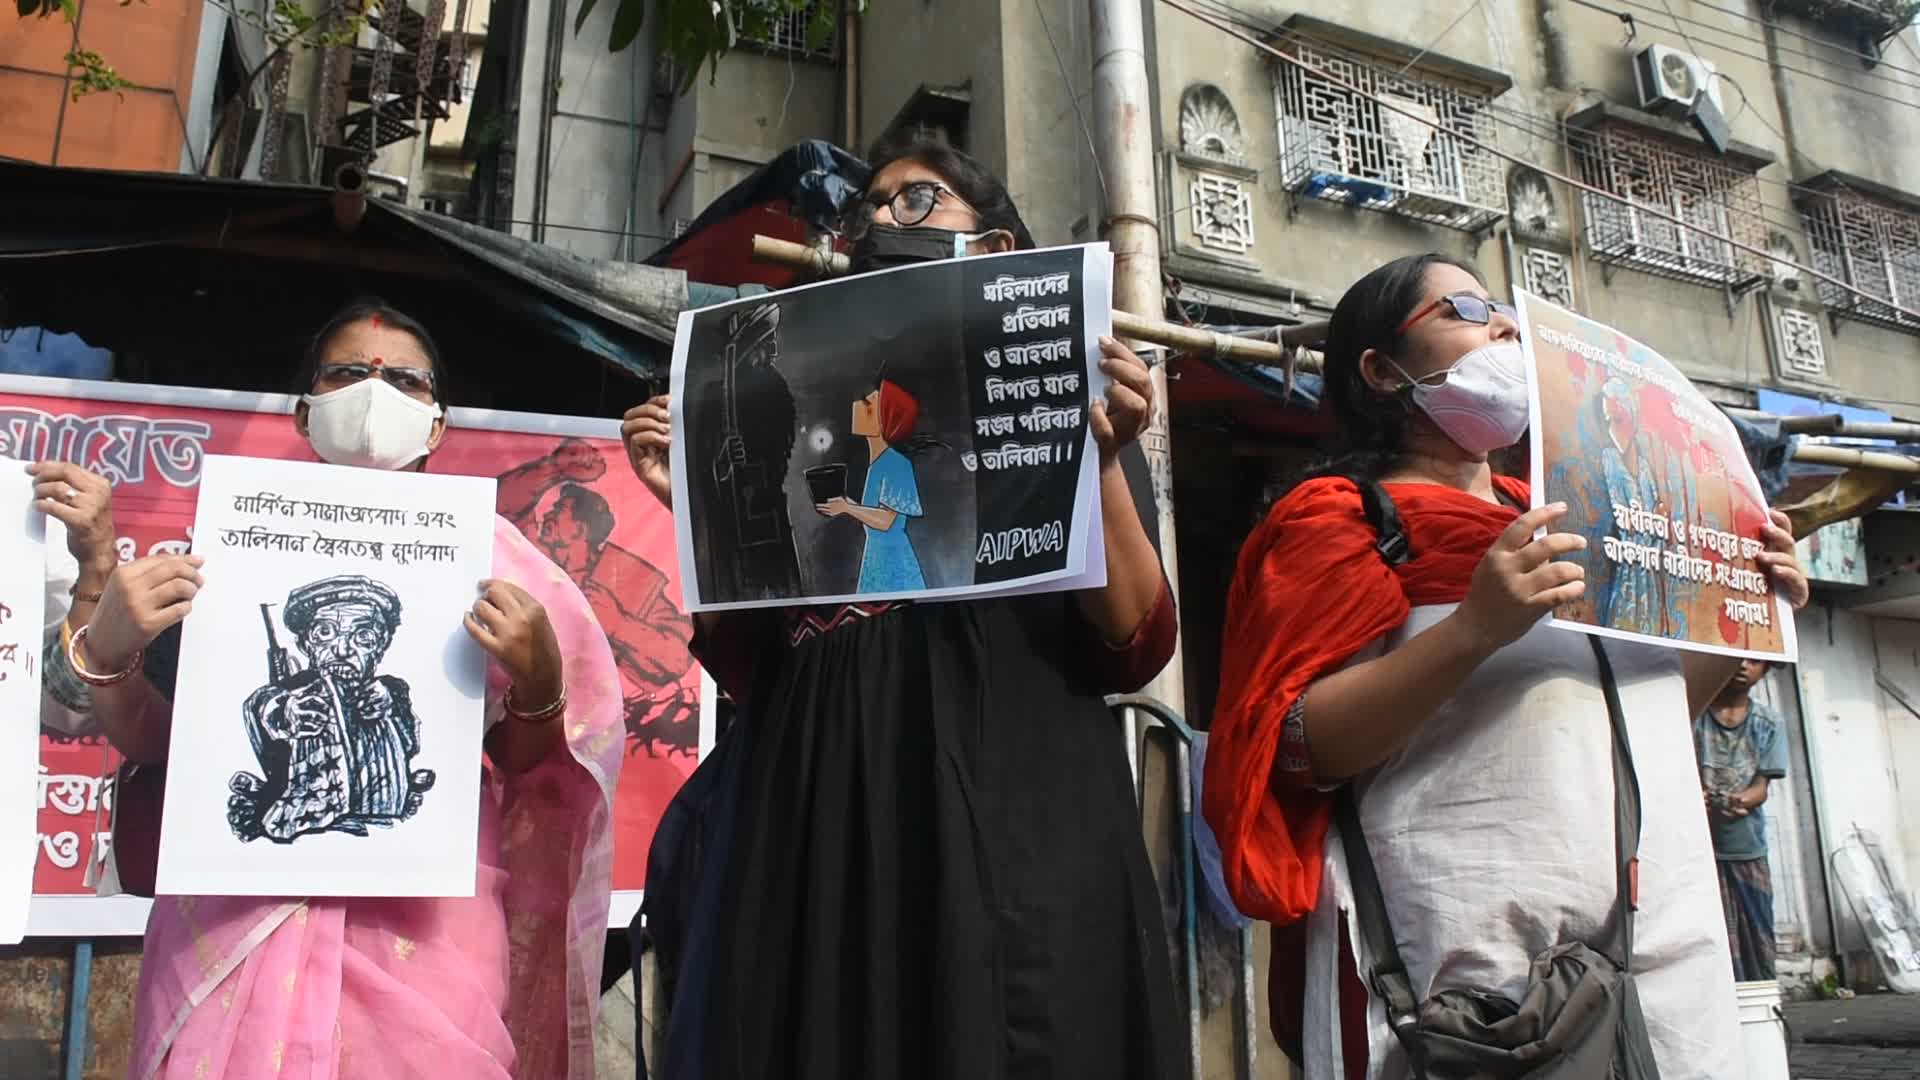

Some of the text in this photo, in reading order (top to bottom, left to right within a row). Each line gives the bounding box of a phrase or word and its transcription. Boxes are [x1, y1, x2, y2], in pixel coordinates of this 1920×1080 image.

[983, 272, 1070, 302] মহিলাদের
[1002, 303, 1071, 333] প্রতিবাদ
[984, 347, 1001, 368] ও
[986, 372, 1080, 403] নিপাত যাক
[1018, 403, 1081, 432] পরিবার
[960, 451, 977, 472] ও
[233, 492, 457, 529] মার্কিন সাম্রাজ্যবাদ এবং
[218, 525, 310, 553] তালিবান
[312, 530, 385, 560] স্বৈরতন্ত্র
[392, 540, 459, 565] মুর্দাবাদ
[976, 520, 1064, 565] AIPWA
[1612, 499, 1669, 540] স্বাধীনতা
[1672, 520, 1686, 543] ও
[1688, 523, 1739, 561] গণতন্ত্রের
[1603, 536, 1768, 595] আফগান নারীদের সংগ্রামকে
[1725, 598, 1770, 625] সালাম!
